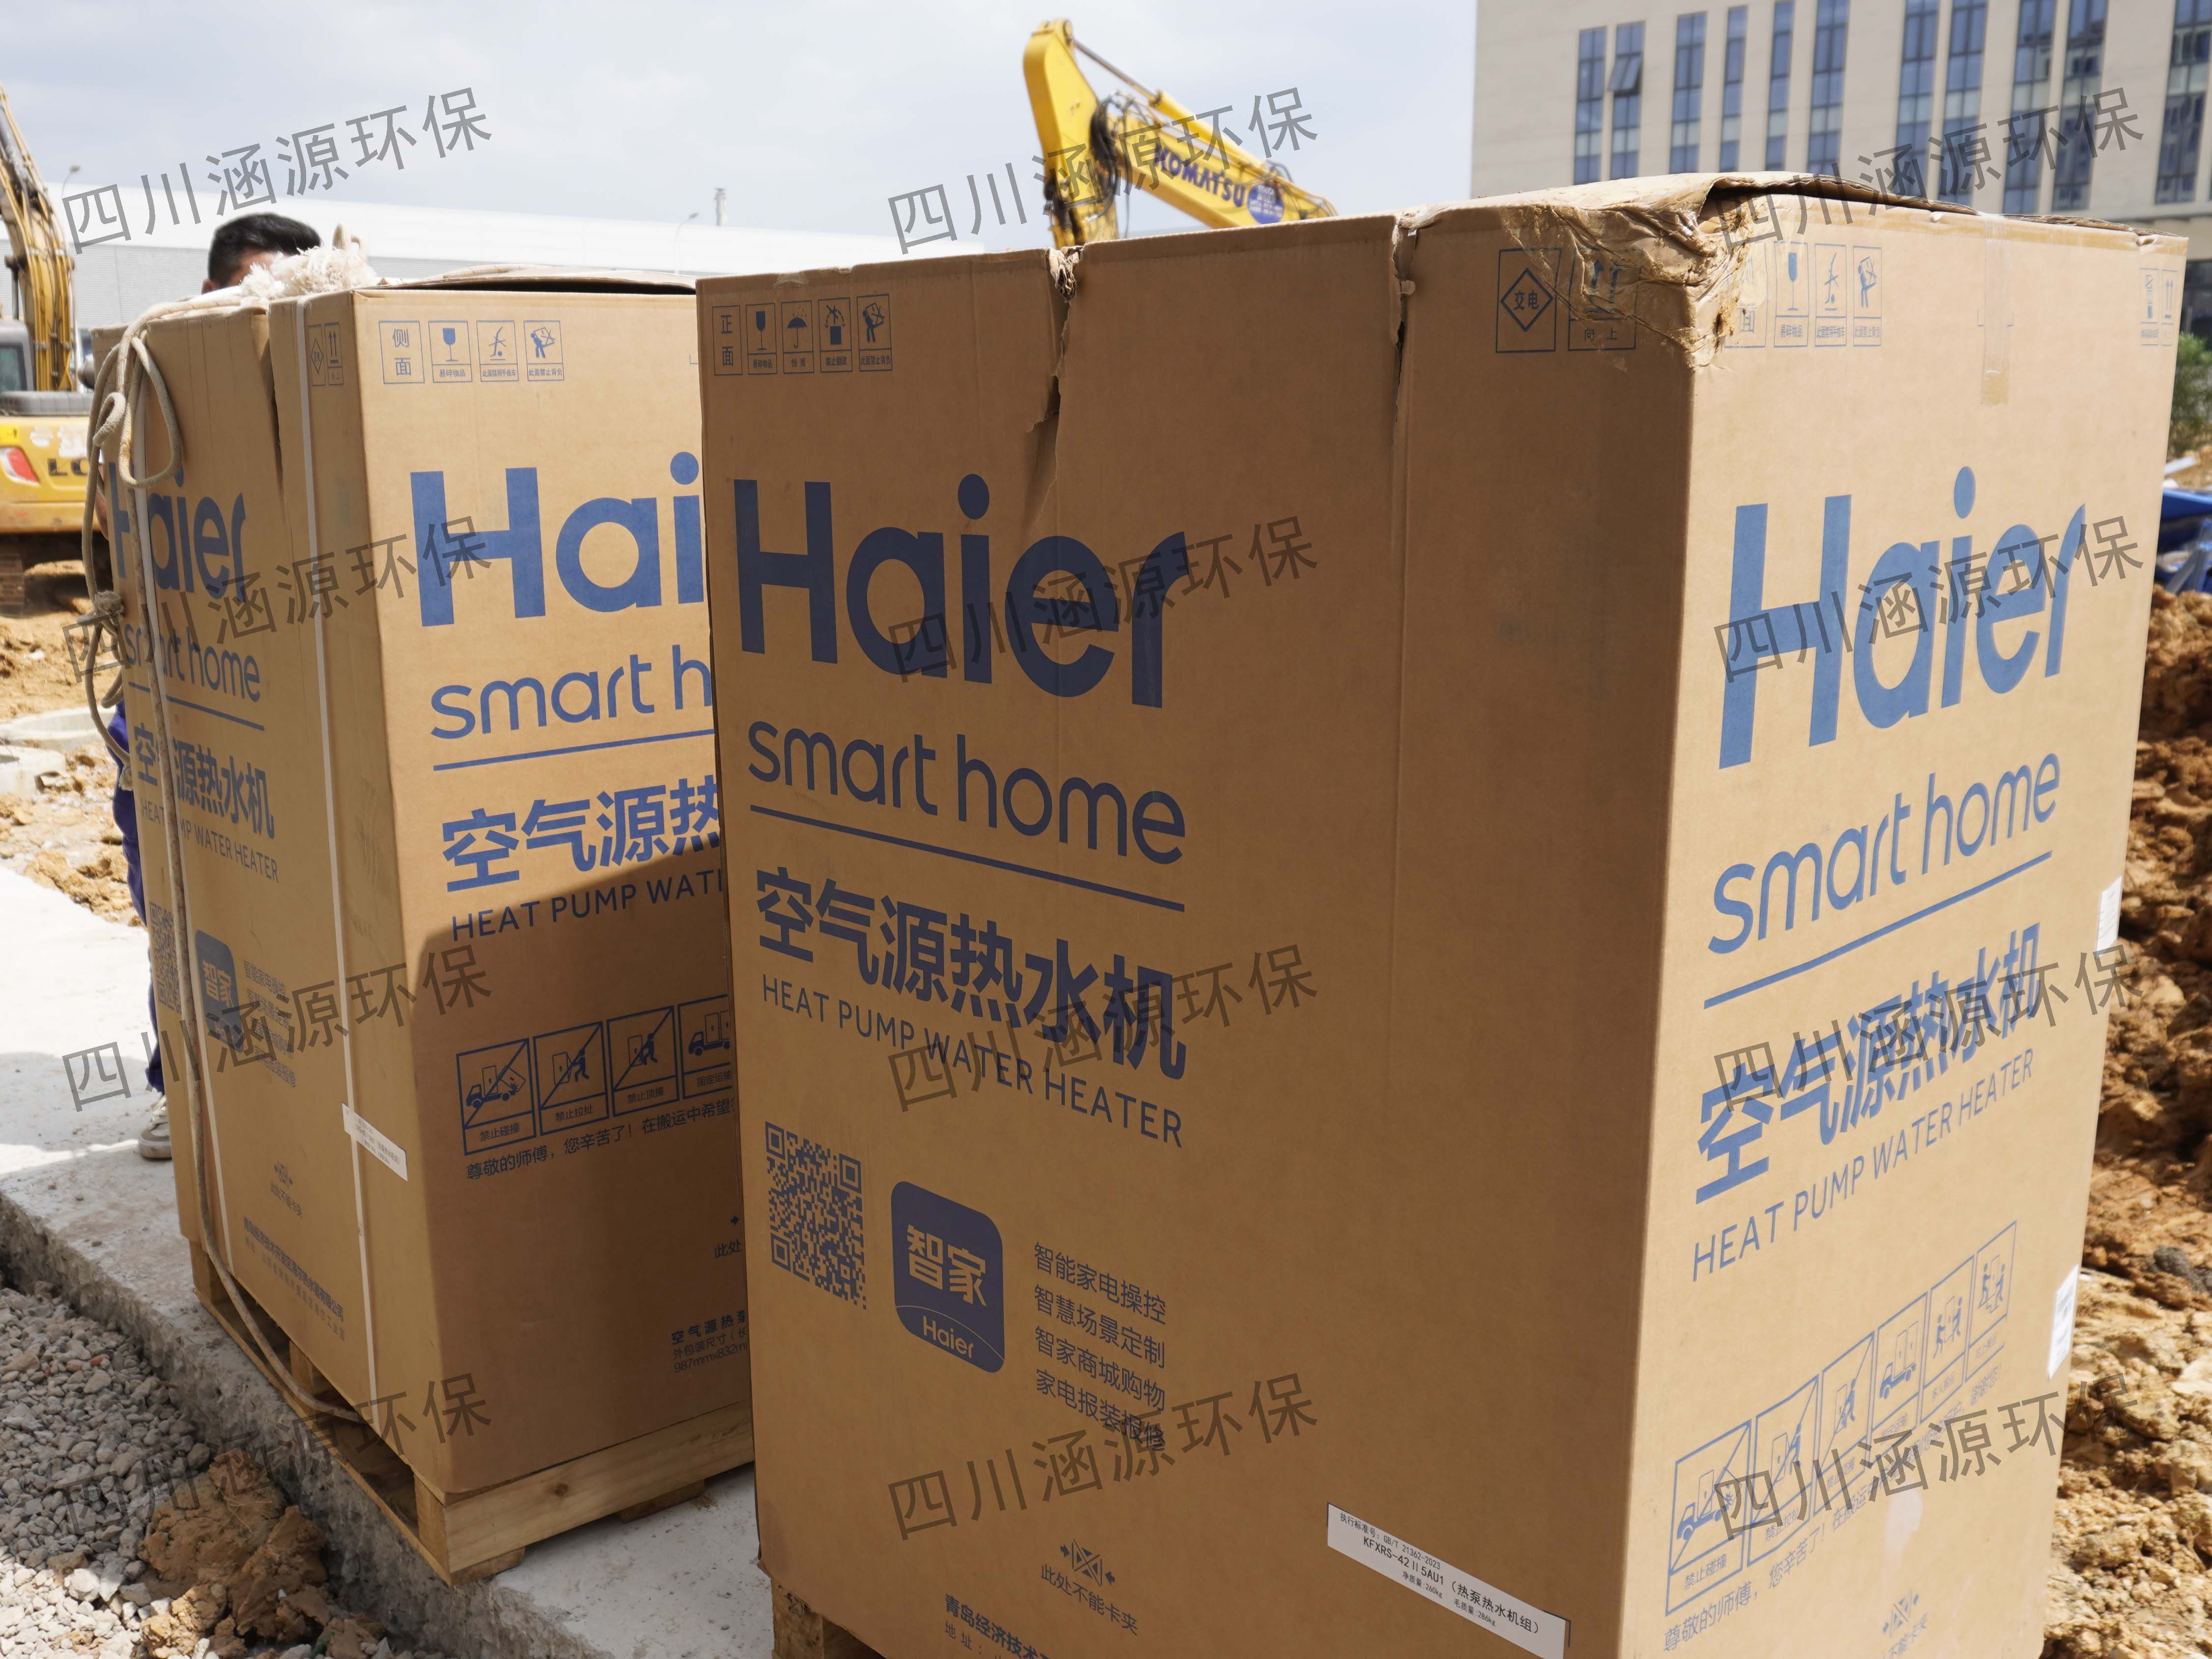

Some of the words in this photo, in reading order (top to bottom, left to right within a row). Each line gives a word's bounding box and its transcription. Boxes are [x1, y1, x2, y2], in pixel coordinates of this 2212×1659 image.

[1154, 143, 1246, 207] KOMATSU
[393, 328, 412, 376] 侧面
[439, 369, 466, 377] 易碎物品
[720, 315, 734, 366] 正面
[109, 462, 246, 602] Haier
[410, 452, 704, 627] Hai
[734, 474, 1189, 708] Haier
[1718, 465, 2086, 769] Haier
[187, 626, 260, 702] home
[430, 655, 655, 740] smart
[134, 722, 275, 840] 空源热水机
[748, 721, 937, 816] smart
[957, 734, 1186, 864] home
[194, 825, 233, 860] WATER
[234, 840, 279, 883] HEATER
[442, 774, 720, 892] 空气源热
[1708, 791, 1911, 954] smart
[1921, 752, 2061, 875] home
[452, 901, 540, 942] HEAT
[551, 884, 636, 922] PUMP
[757, 867, 1187, 1080] 空气源热水机
[762, 974, 829, 1022] HEAT
[839, 1000, 915, 1049] PUMP
[923, 1027, 1033, 1094] WATER
[1045, 1067, 1182, 1148] HEATER
[1696, 922, 2040, 1205] 空气源热水机
[480, 1123, 519, 1142] 禁止碰撞
[555, 1105, 594, 1122] 禁止拉扯
[1692, 1201, 1785, 1282] HEAT
[1793, 1155, 1865, 1231] PUMP
[1872, 1101, 1952, 1180] WATER
[1958, 1048, 2034, 1131] HEATER
[907, 1224, 987, 1307] 智家
[1034, 1242, 1166, 1325] 智能家电操控
[922, 1315, 974, 1359] Haier
[1034, 1285, 1165, 1369] 智慧场景定制
[1034, 1325, 1165, 1412] 智家商城购物
[1035, 1369, 1166, 1452] 家电报装报修
[1402, 1544, 1441, 1570] 21362-2023
[1684, 1553, 1727, 1591] 禁止碰撞
[945, 1593, 1050, 1659] 青岛经济技术
[1040, 1563, 1139, 1636] 此处不能卡夹
